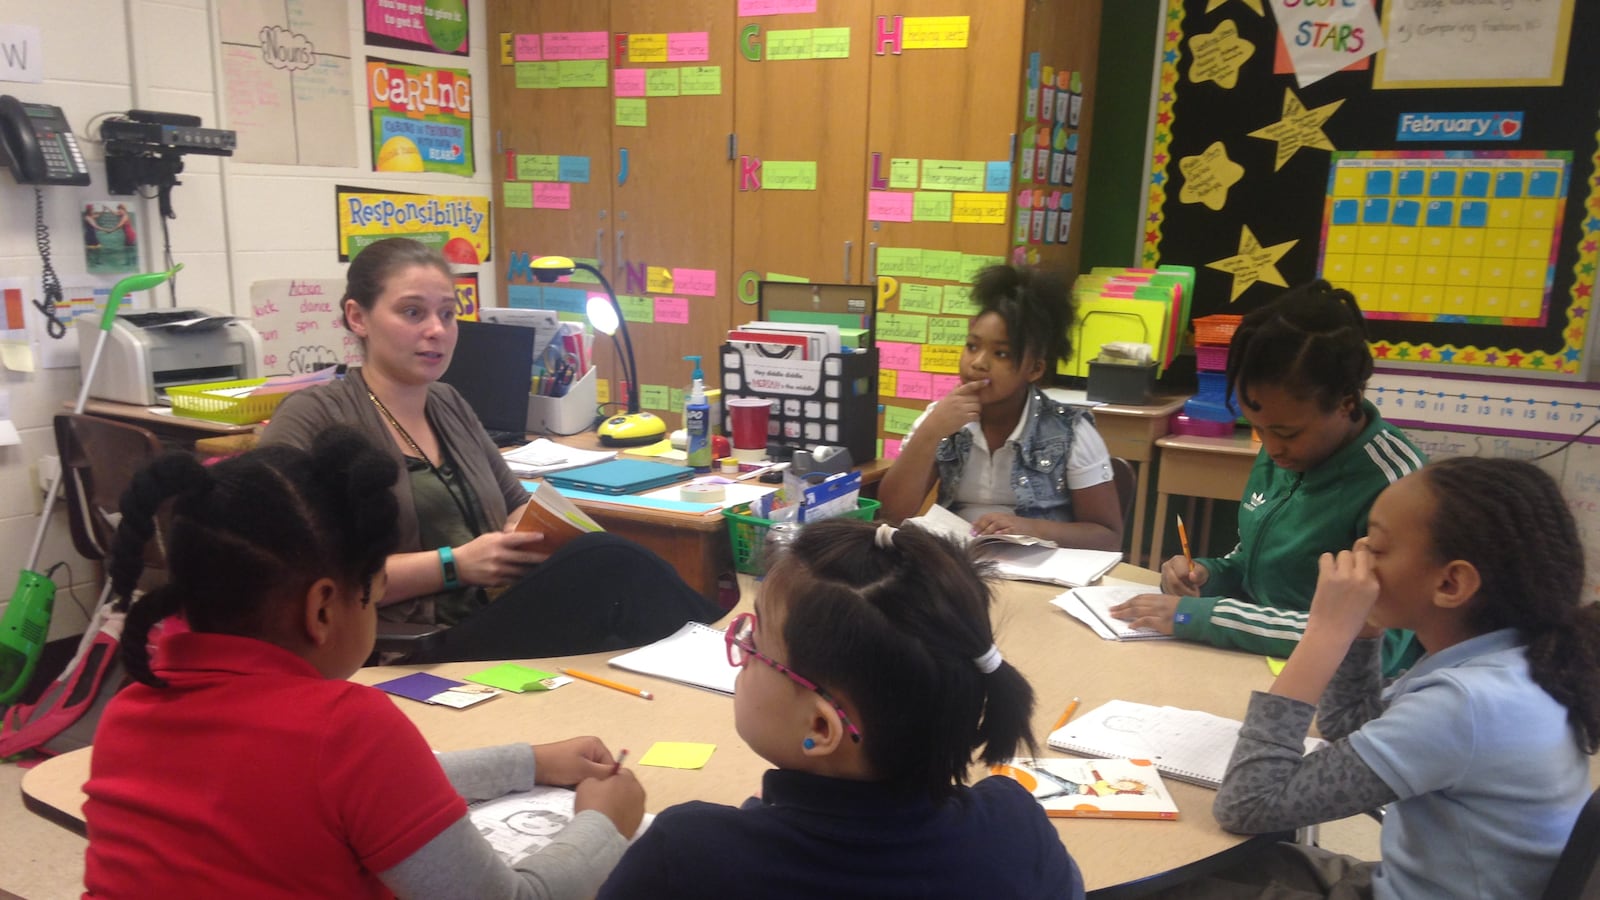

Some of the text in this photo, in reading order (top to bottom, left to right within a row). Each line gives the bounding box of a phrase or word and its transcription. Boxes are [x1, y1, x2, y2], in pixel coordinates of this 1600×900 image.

[501, 32, 514, 66] E
[614, 33, 628, 69] F
[740, 24, 761, 62] G
[876, 16, 902, 55] H
[1295, 20, 1364, 53] STARS
[1, 39, 28, 70] W
[1401, 114, 1492, 137] February
[617, 147, 629, 187] J
[739, 154, 761, 192] K
[870, 154, 887, 191] L
[348, 198, 484, 234] Responsibility
[507, 250, 534, 282] M
[626, 259, 648, 295] N
[876, 276, 898, 311] P
[1413, 400, 1427, 410] 10
[1432, 402, 1446, 412] 11
[1455, 404, 1469, 414] 12
[1477, 405, 1491, 416] 13
[1499, 407, 1515, 417] 14
[1523, 409, 1537, 420] 15
[1546, 411, 1561, 422] 16
[1569, 412, 1585, 423] 17
